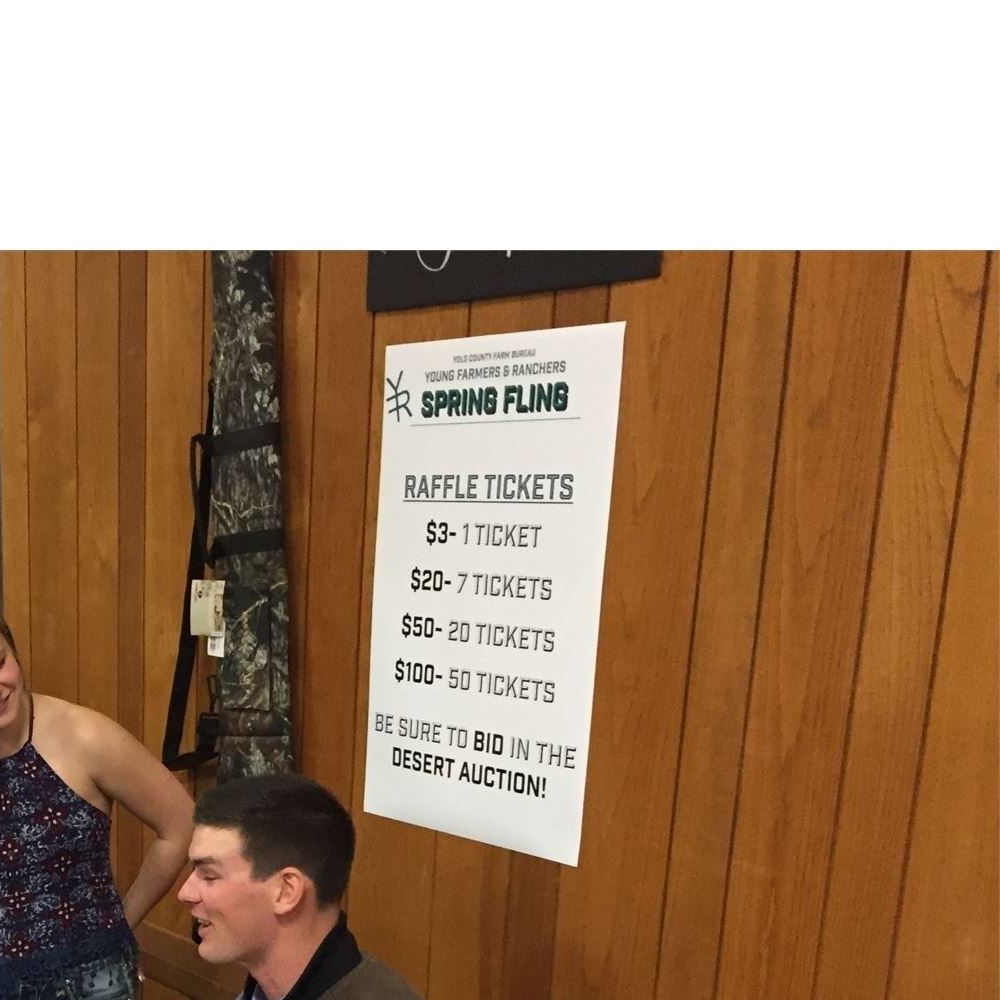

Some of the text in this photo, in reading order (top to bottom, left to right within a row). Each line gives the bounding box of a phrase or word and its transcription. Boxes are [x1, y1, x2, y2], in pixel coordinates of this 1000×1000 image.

[425, 360, 566, 383] YOUNG FARMERS & RANCHERS
[469, 353, 492, 362] COUNTY
[493, 351, 510, 360] FARM
[511, 348, 536, 359] BUREAU
[421, 381, 569, 418] SPRING FLING
[404, 474, 574, 500] RAFFLE TICKETS
[426, 519, 542, 548] $3- 1 TICKET
[411, 566, 553, 601] $20- 7 TICKETS
[401, 612, 555, 653] $50- 20 TICKETS
[394, 658, 556, 703] $100- 50 TICKETS
[374, 712, 577, 769] BE SURE TO BID IN THE
[392, 746, 547, 799] DESERT AUCTION!
